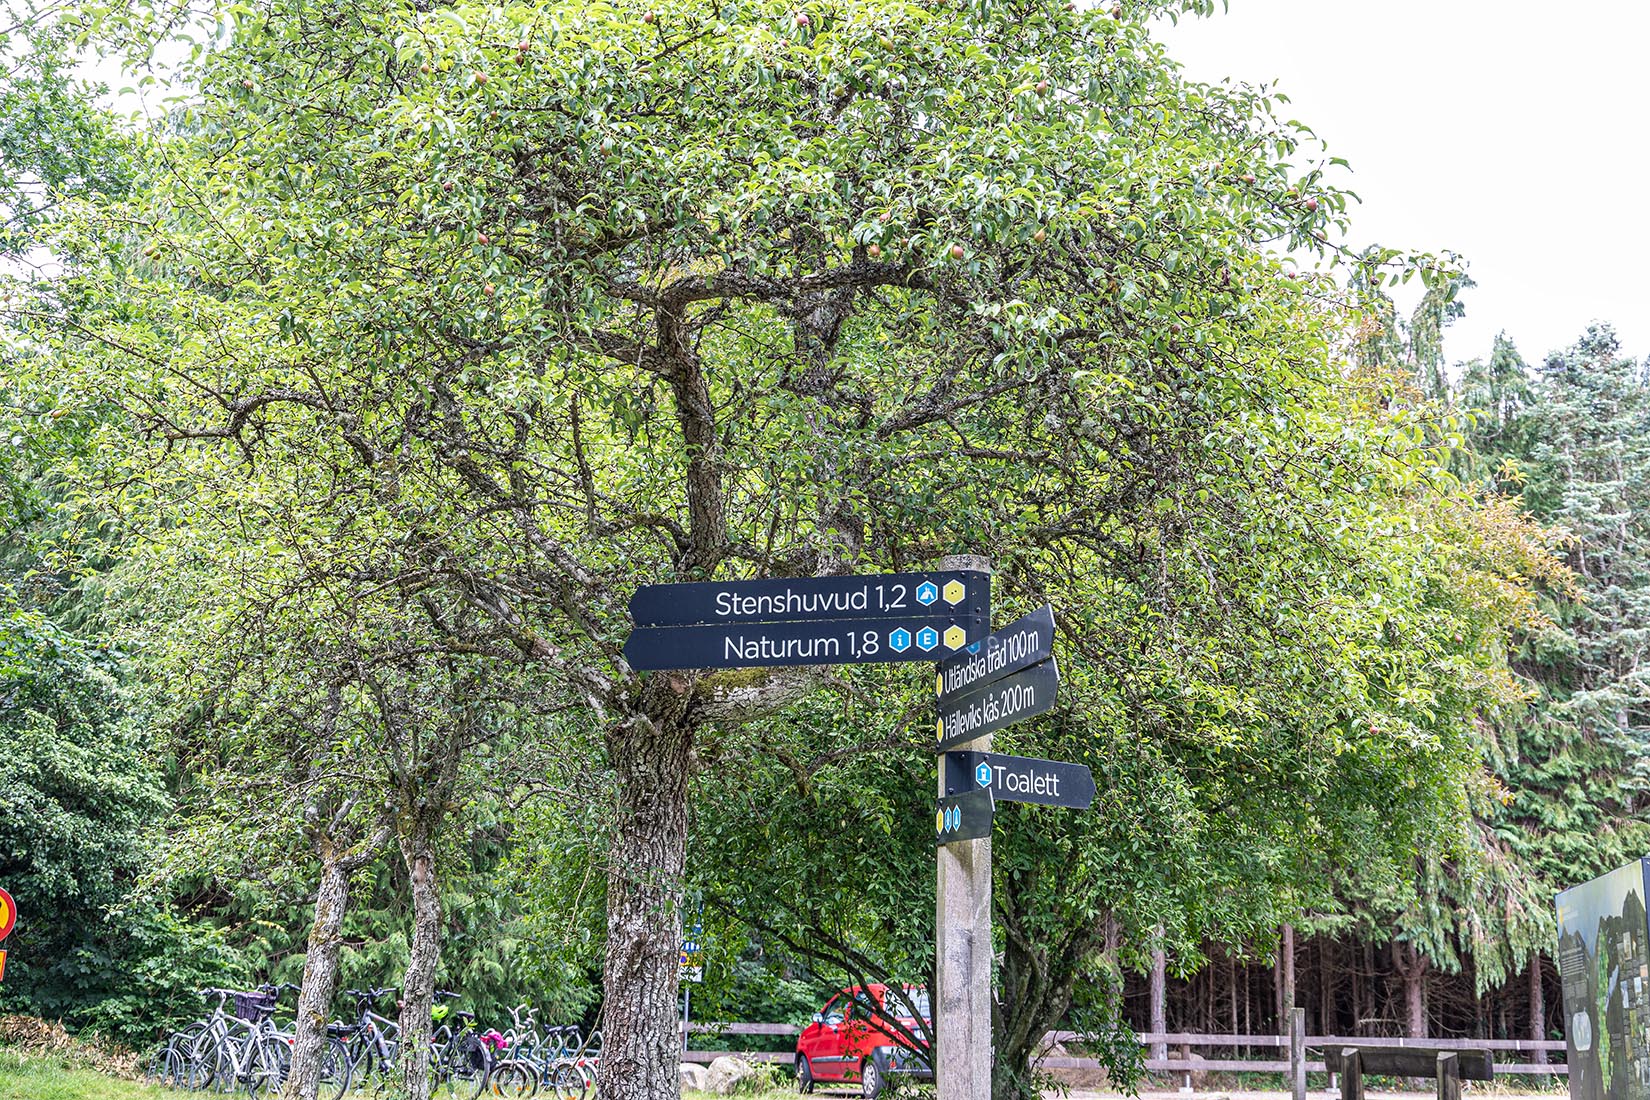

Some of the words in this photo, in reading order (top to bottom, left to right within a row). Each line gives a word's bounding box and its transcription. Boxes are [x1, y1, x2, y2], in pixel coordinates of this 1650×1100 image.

[715, 585, 867, 616] Stenshuvud
[876, 584, 907, 612] 1,2
[724, 636, 840, 660] Naturum
[847, 631, 879, 660] 1,8
[944, 655, 986, 694] Utländska
[987, 638, 1007, 674] träd
[945, 703, 982, 740] Hälleviks
[983, 693, 1000, 725] kås
[993, 765, 1060, 797] Toalett
